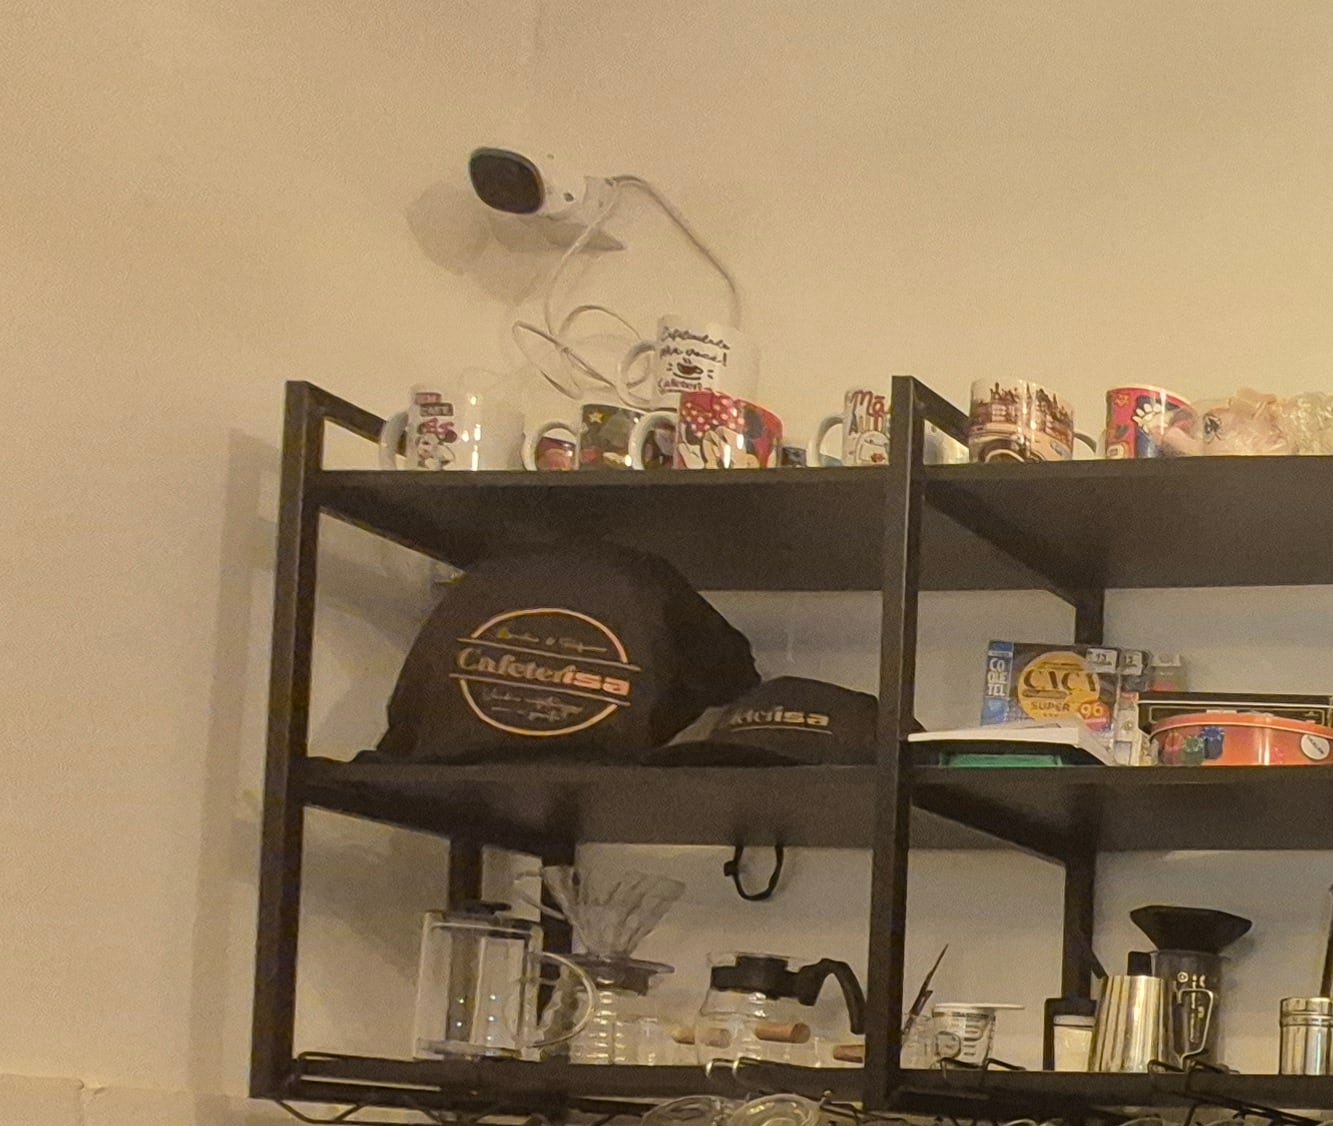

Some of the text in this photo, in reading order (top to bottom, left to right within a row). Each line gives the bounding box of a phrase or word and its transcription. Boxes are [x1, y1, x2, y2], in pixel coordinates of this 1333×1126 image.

[990, 658, 1005, 672] CO
[458, 648, 630, 696] Cafeterisa
[987, 672, 1008, 684] QUE
[988, 684, 1006, 697] TEL
[1030, 702, 1070, 712] SUPER
[1079, 703, 1104, 717] 96
